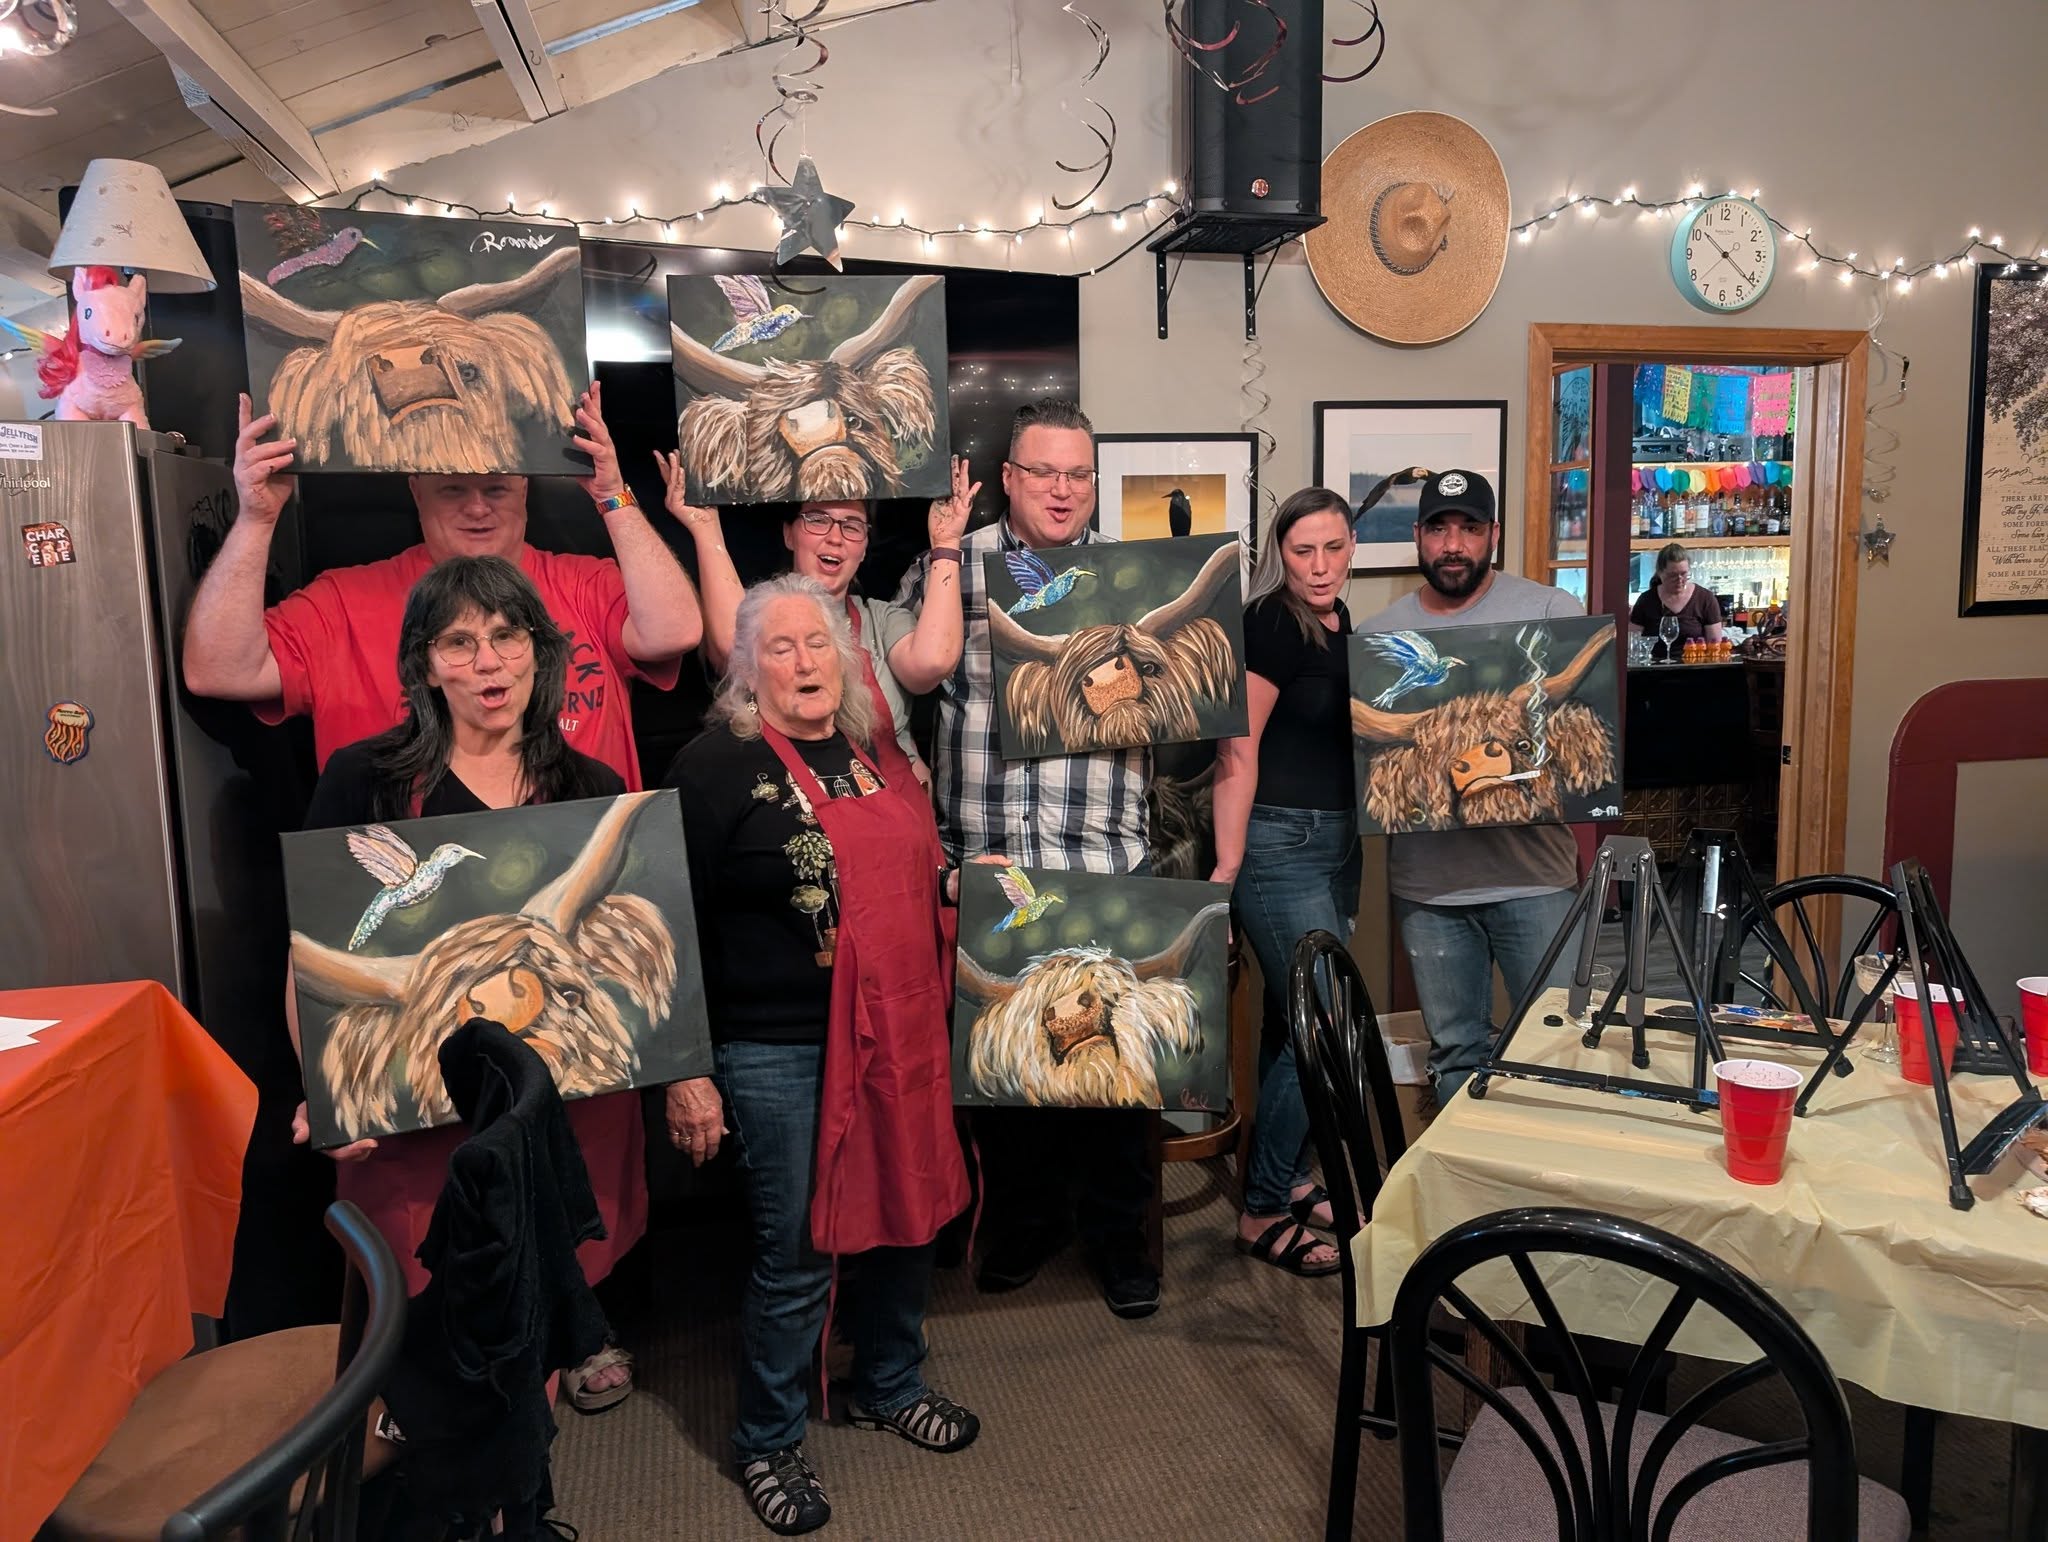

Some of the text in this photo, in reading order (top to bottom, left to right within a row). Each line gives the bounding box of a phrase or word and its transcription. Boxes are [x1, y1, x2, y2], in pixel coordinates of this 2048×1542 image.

[1706, 214, 1713, 226] 11
[1720, 209, 1731, 221] 12
[1741, 215, 1744, 227] 1
[1692, 229, 1702, 241] 10
[1750, 230, 1757, 242] 2
[1686, 248, 1693, 260] 9
[1755, 251, 1762, 263] 3
[1691, 269, 1697, 281] 8
[1748, 272, 1755, 282] 4
[1703, 284, 1710, 296] 7
[1719, 290, 1726, 302] 6
[1736, 286, 1743, 297] 5
[0, 426, 38, 443] JELLYFISH
[26, 528, 69, 541] CHAR
[31, 551, 71, 565] ERIE
